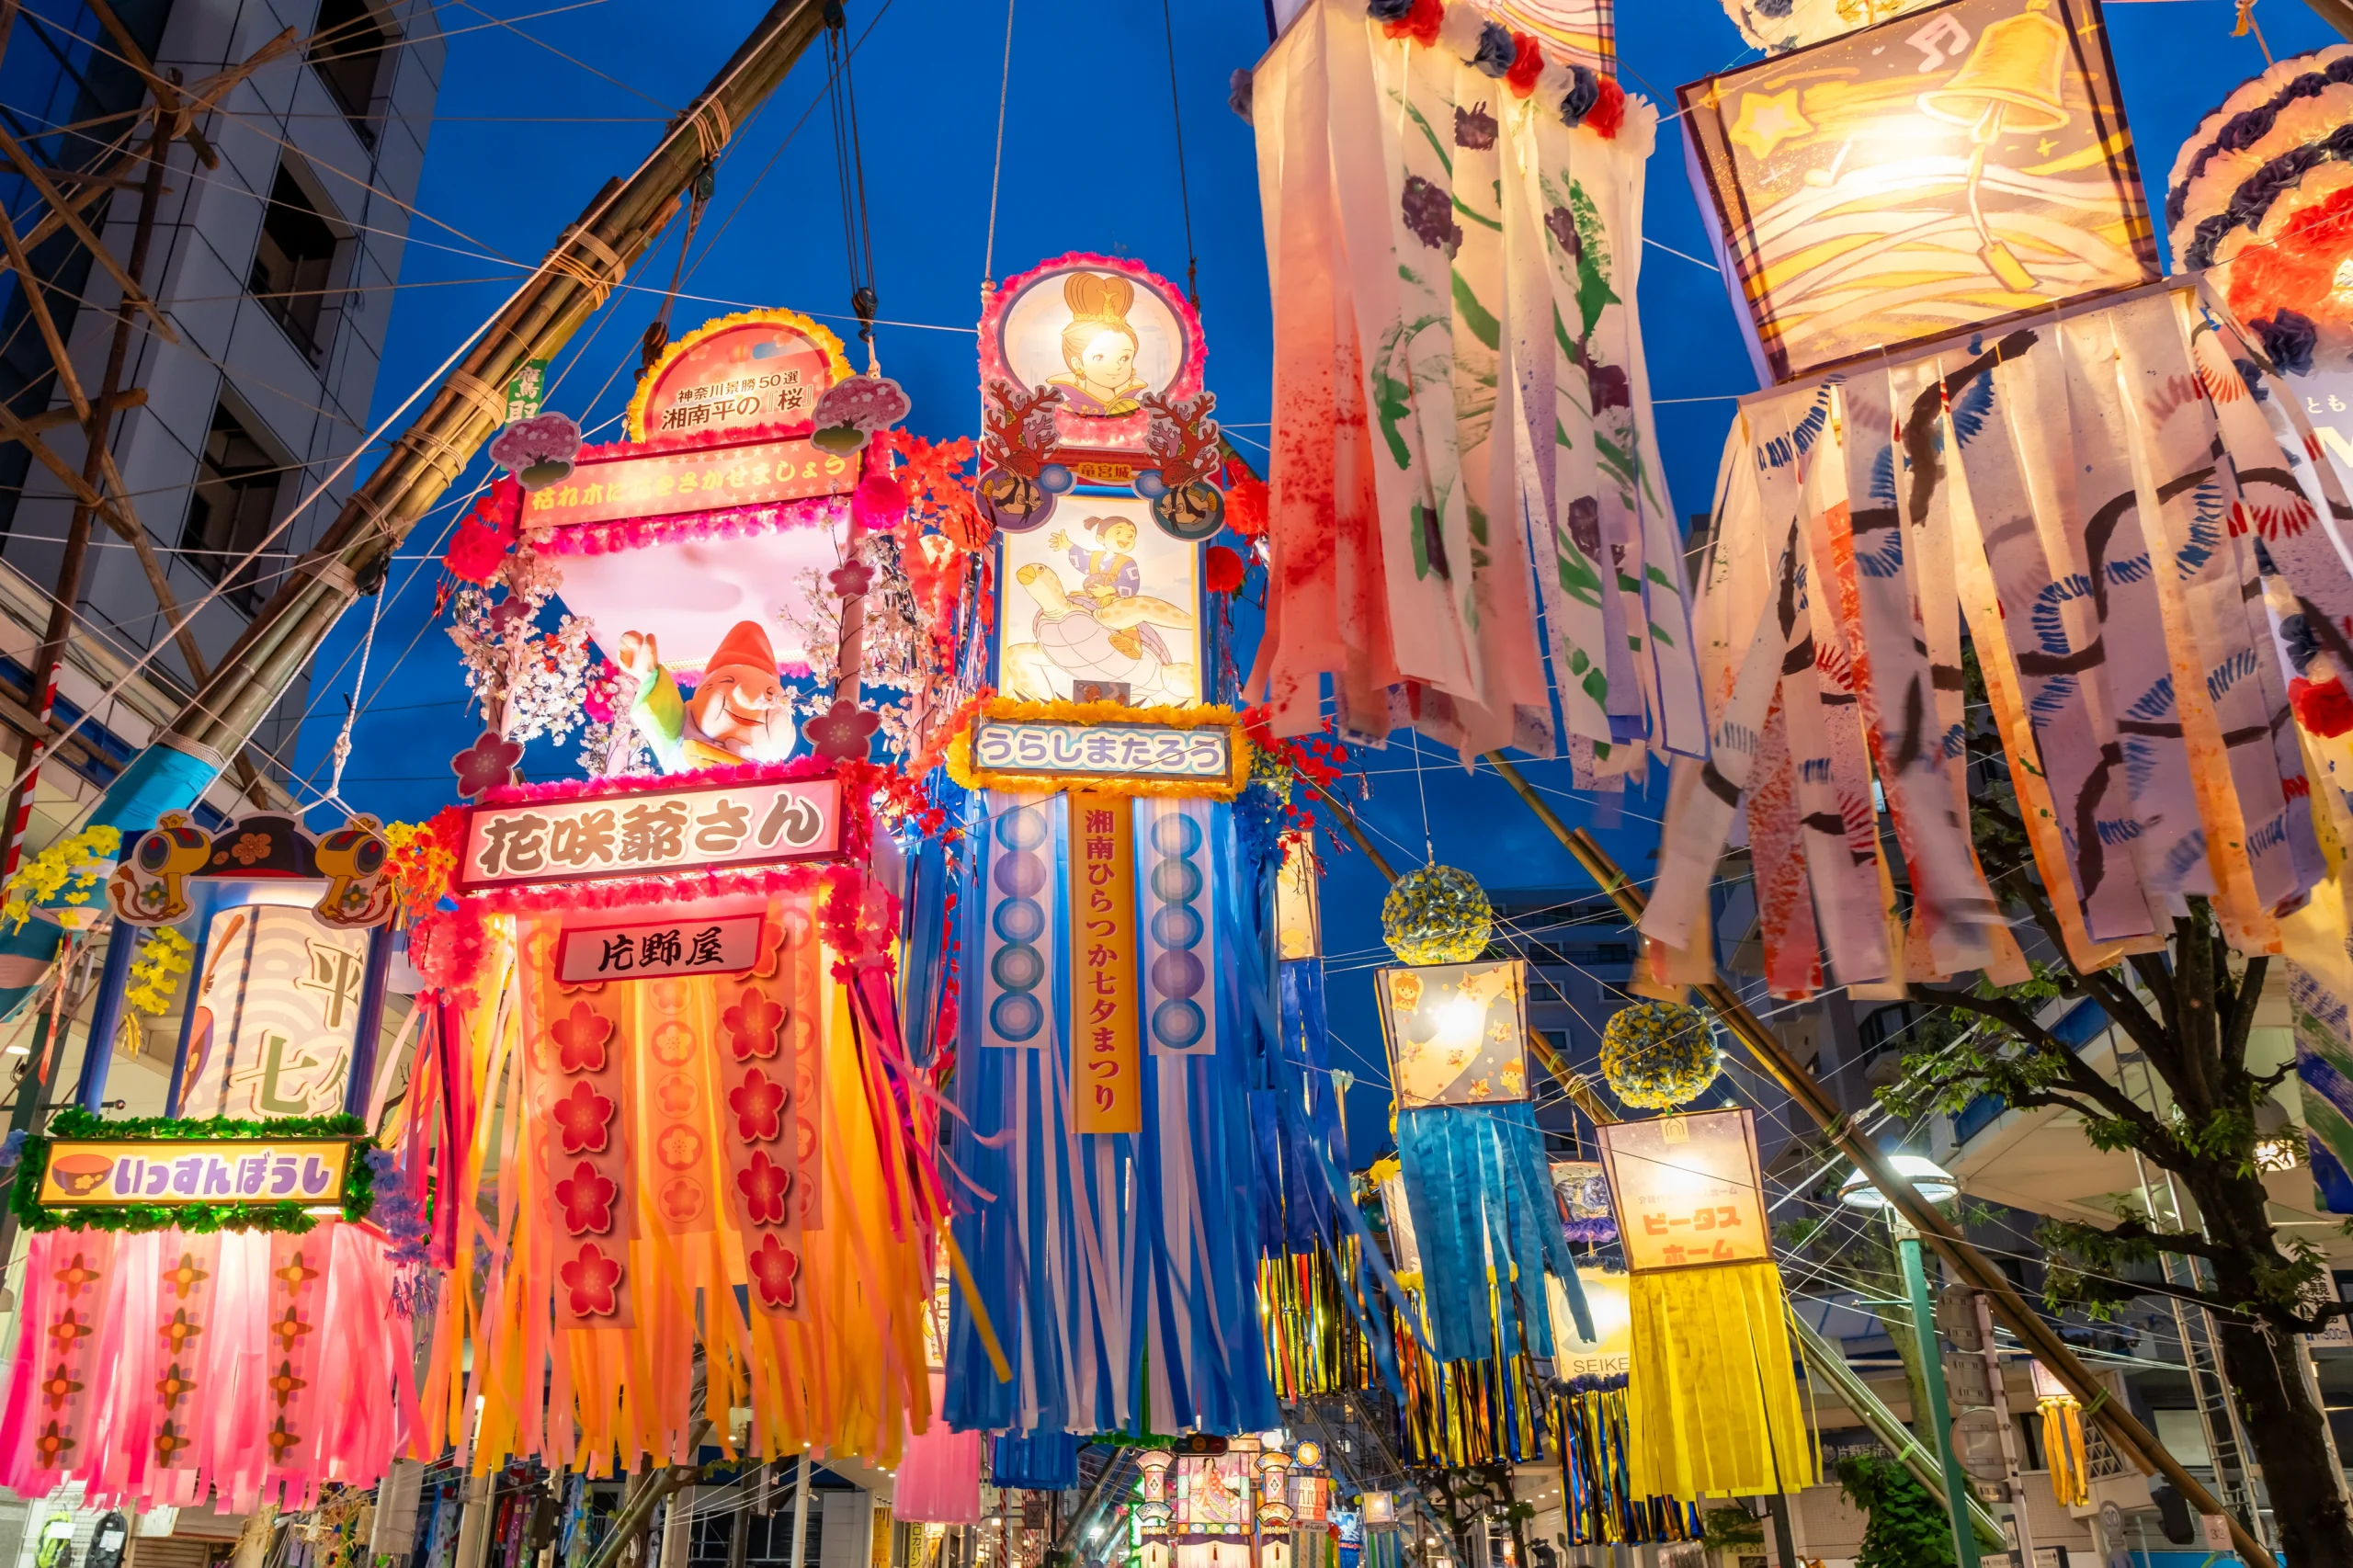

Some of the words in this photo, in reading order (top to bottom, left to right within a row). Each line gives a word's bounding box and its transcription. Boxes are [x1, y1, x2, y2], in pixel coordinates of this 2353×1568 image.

[678, 371, 799, 403] 神奈川景勝50選
[662, 386, 813, 430] 湘南平の『桜』
[1081, 463, 1131, 479] 竜宮城
[981, 734, 1220, 769] うらしまたろう
[480, 793, 820, 874] 花咲爺さん
[598, 926, 724, 971] 片野屋
[1086, 810, 1118, 1113] 湘南ひらつか七夕まつり
[114, 1153, 329, 1196] いっすんぼうし
[1643, 1205, 1742, 1236] ビータス
[1663, 1239, 1734, 1266] ホーム
[1290, 1488, 1327, 1506] PARIS
[2210, 1528, 2226, 1540] 32
